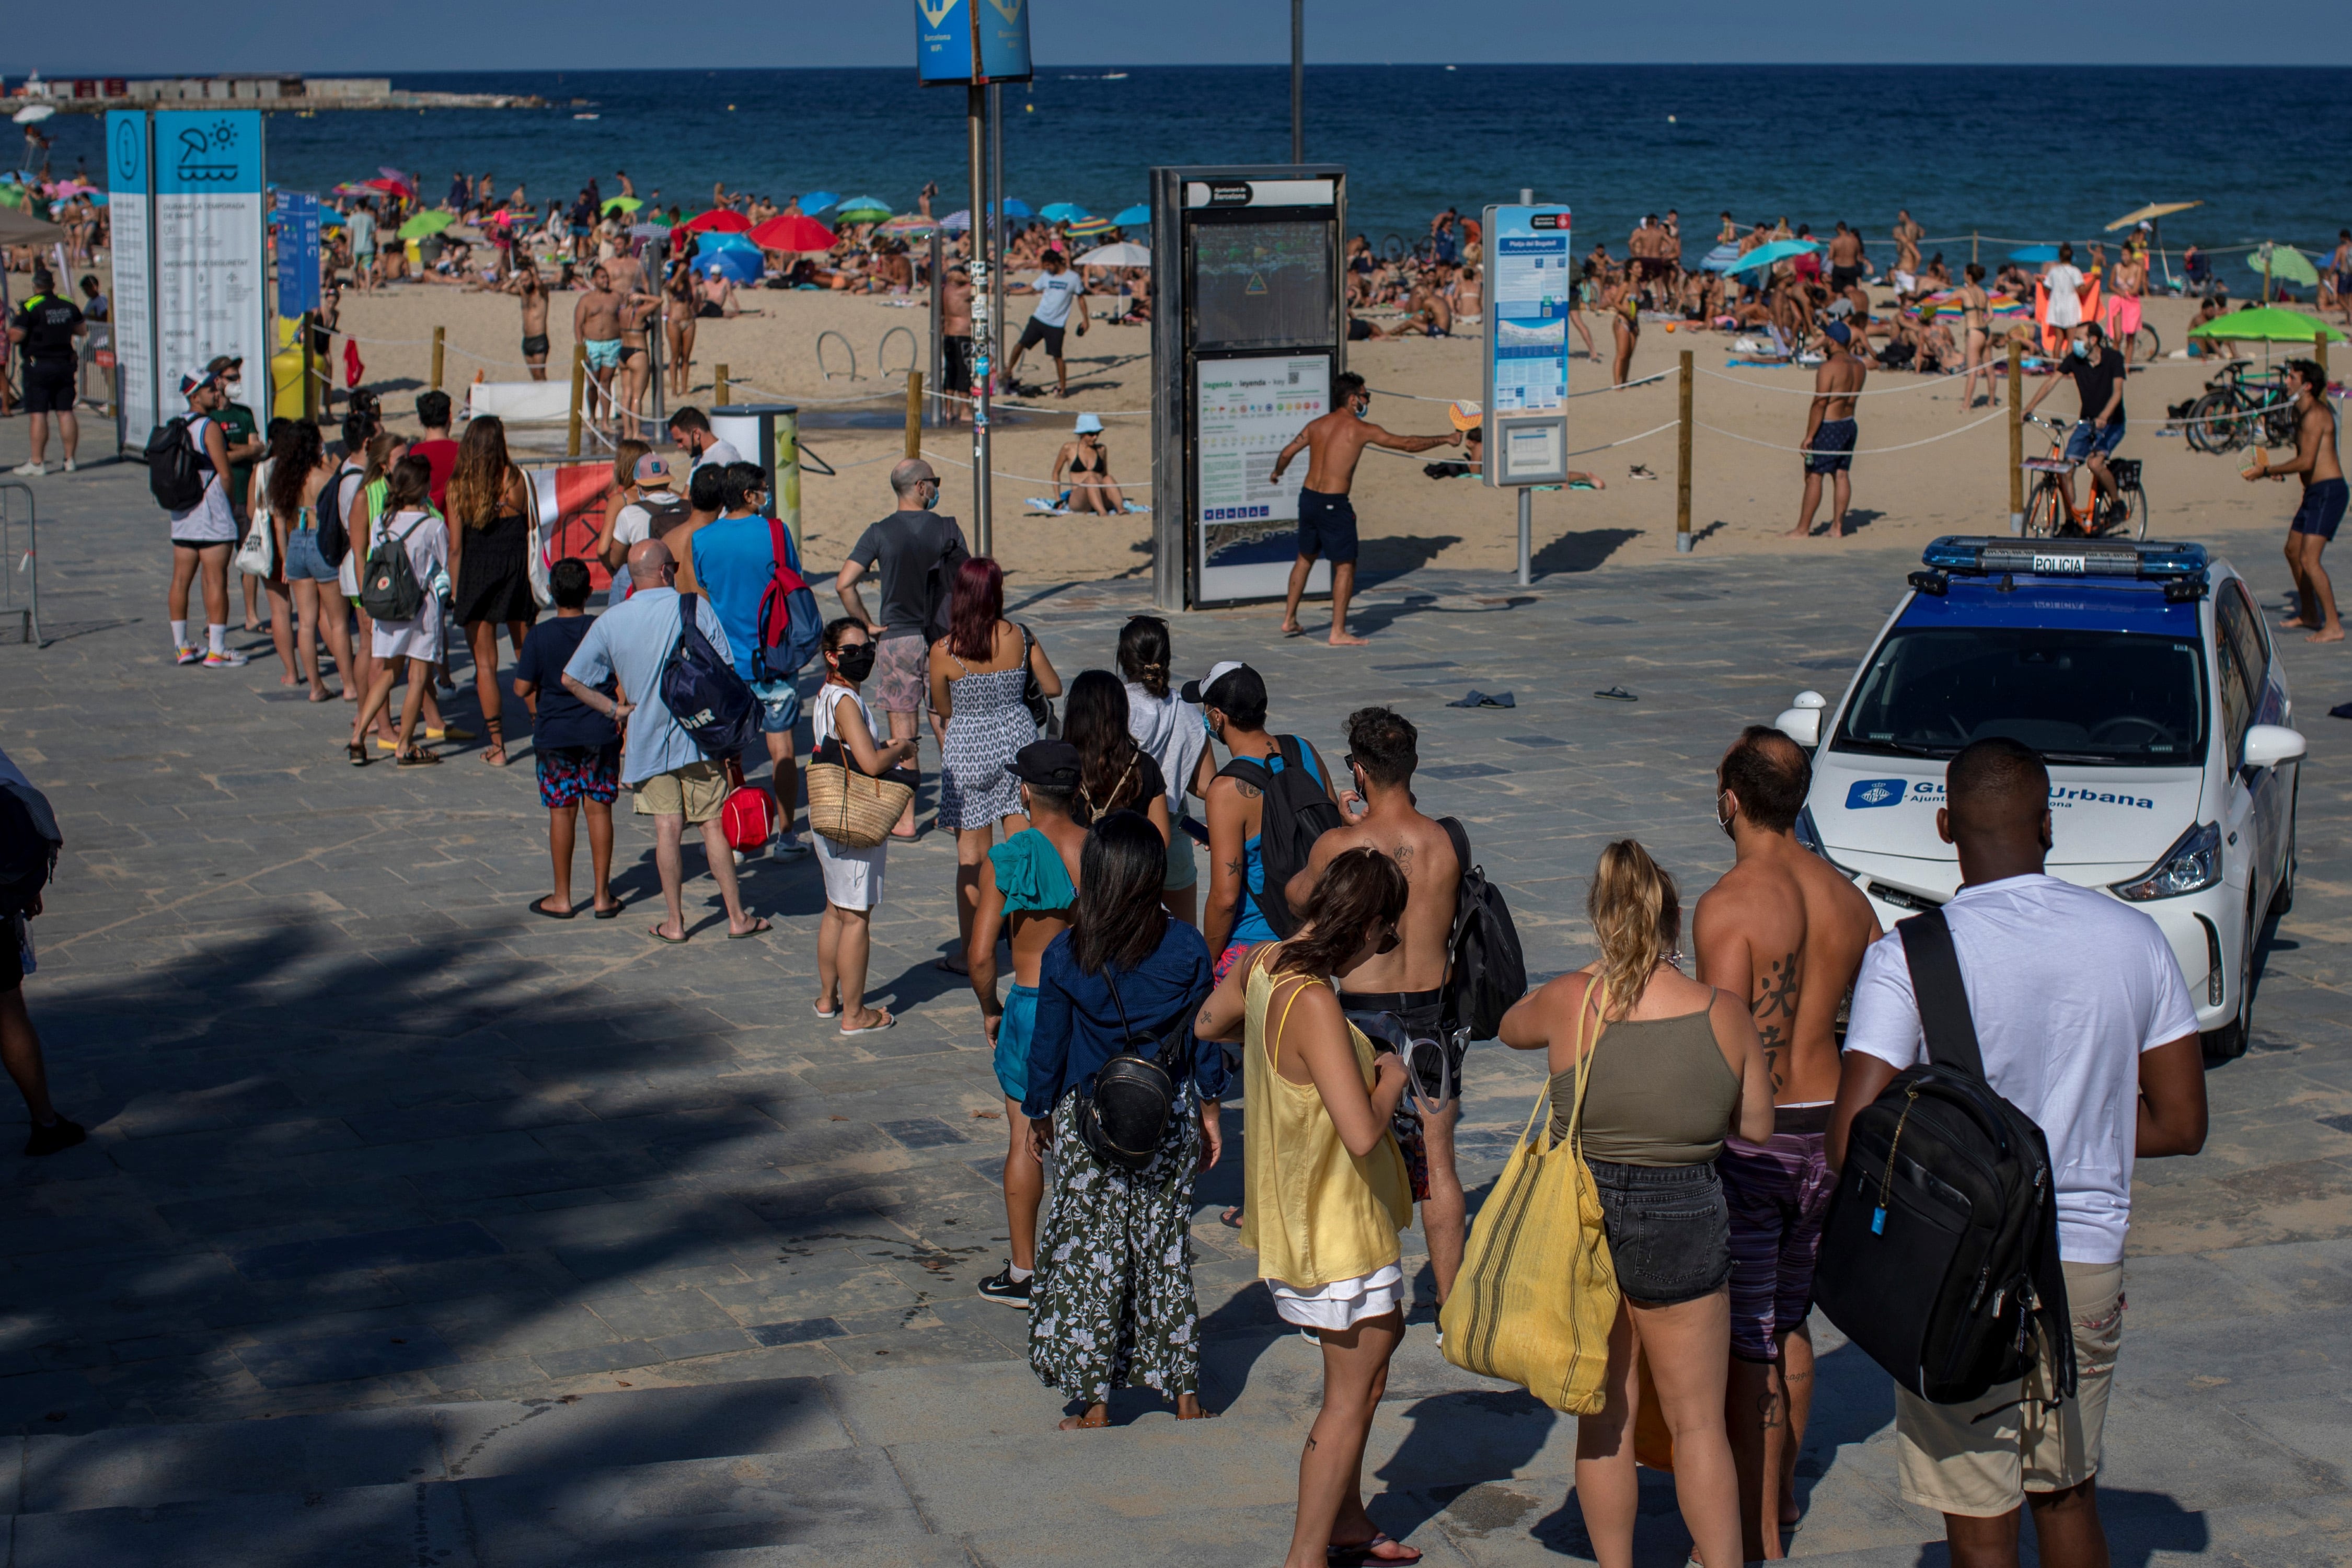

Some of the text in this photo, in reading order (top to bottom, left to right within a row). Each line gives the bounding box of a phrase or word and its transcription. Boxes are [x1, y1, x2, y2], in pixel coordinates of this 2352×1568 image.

[204, 202, 245, 210] TEMPORADA
[210, 259, 248, 267] SEGURETAT
[1203, 380, 1232, 390] llegenda
[1239, 379, 1266, 388] leyenda
[2036, 558, 2081, 572] POLICIA
[1913, 782, 2153, 810] Gu Urbana
